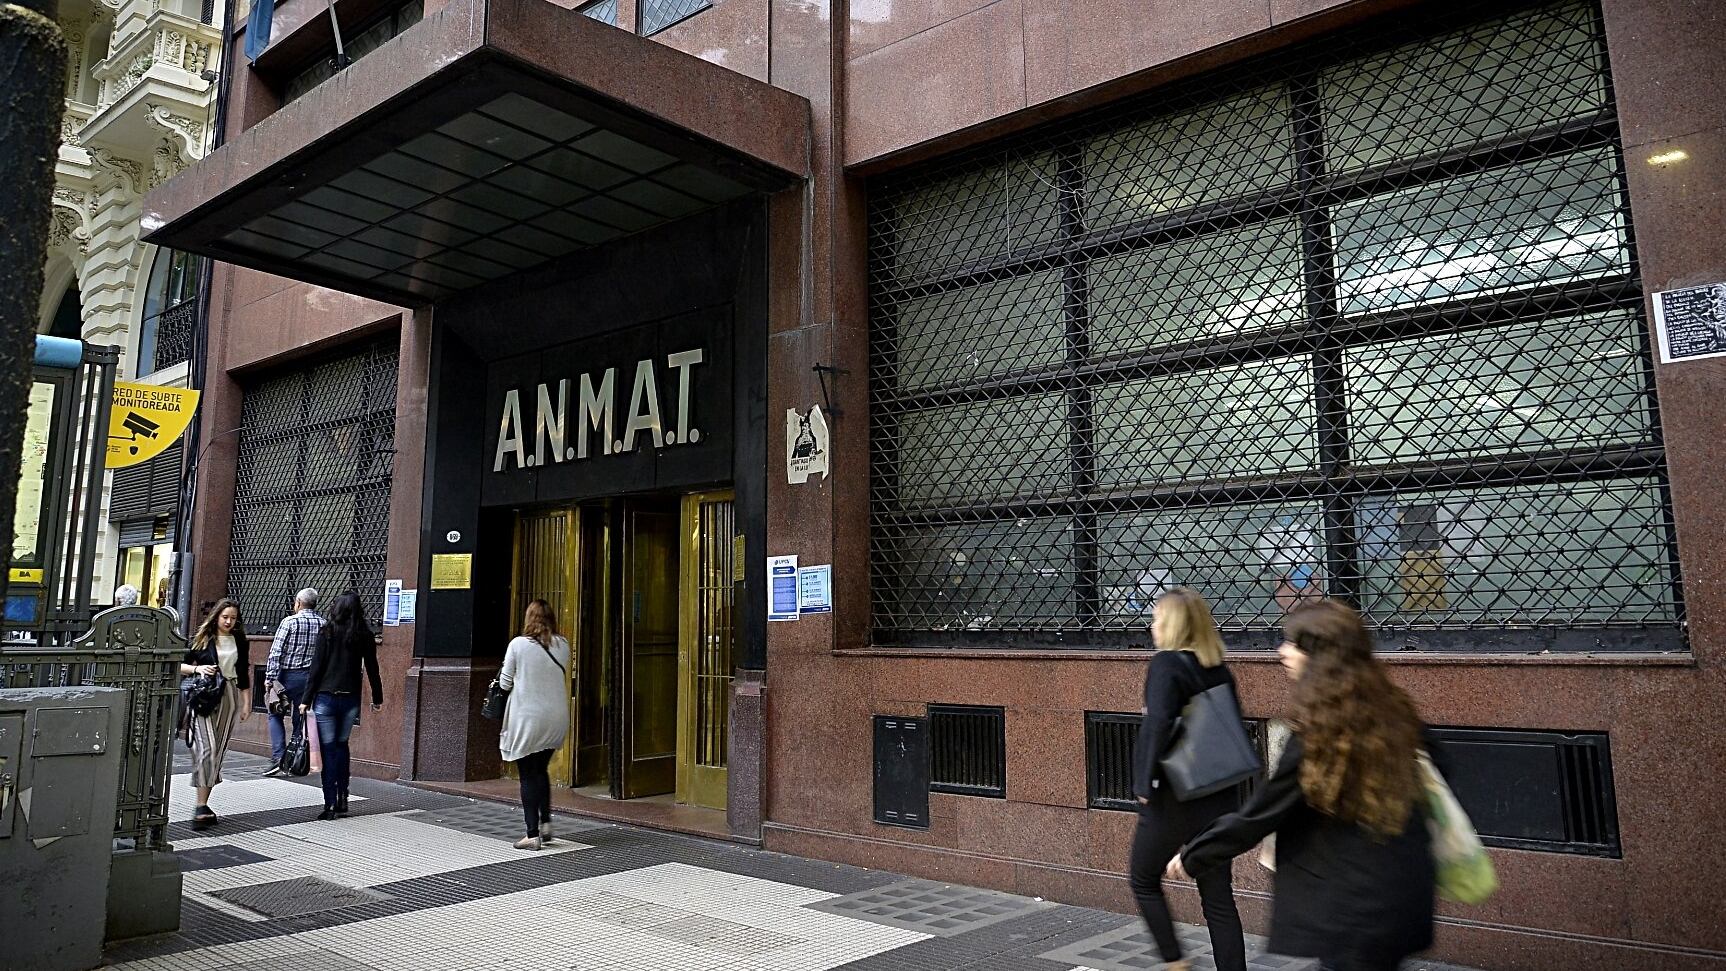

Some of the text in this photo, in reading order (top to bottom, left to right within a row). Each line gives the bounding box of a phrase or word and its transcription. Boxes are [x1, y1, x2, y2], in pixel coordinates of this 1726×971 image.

[113, 388, 182, 403] RED DE SUBTE
[112, 397, 181, 412] MONITOREADA
[493, 347, 703, 473] A.N.M.A.T.
